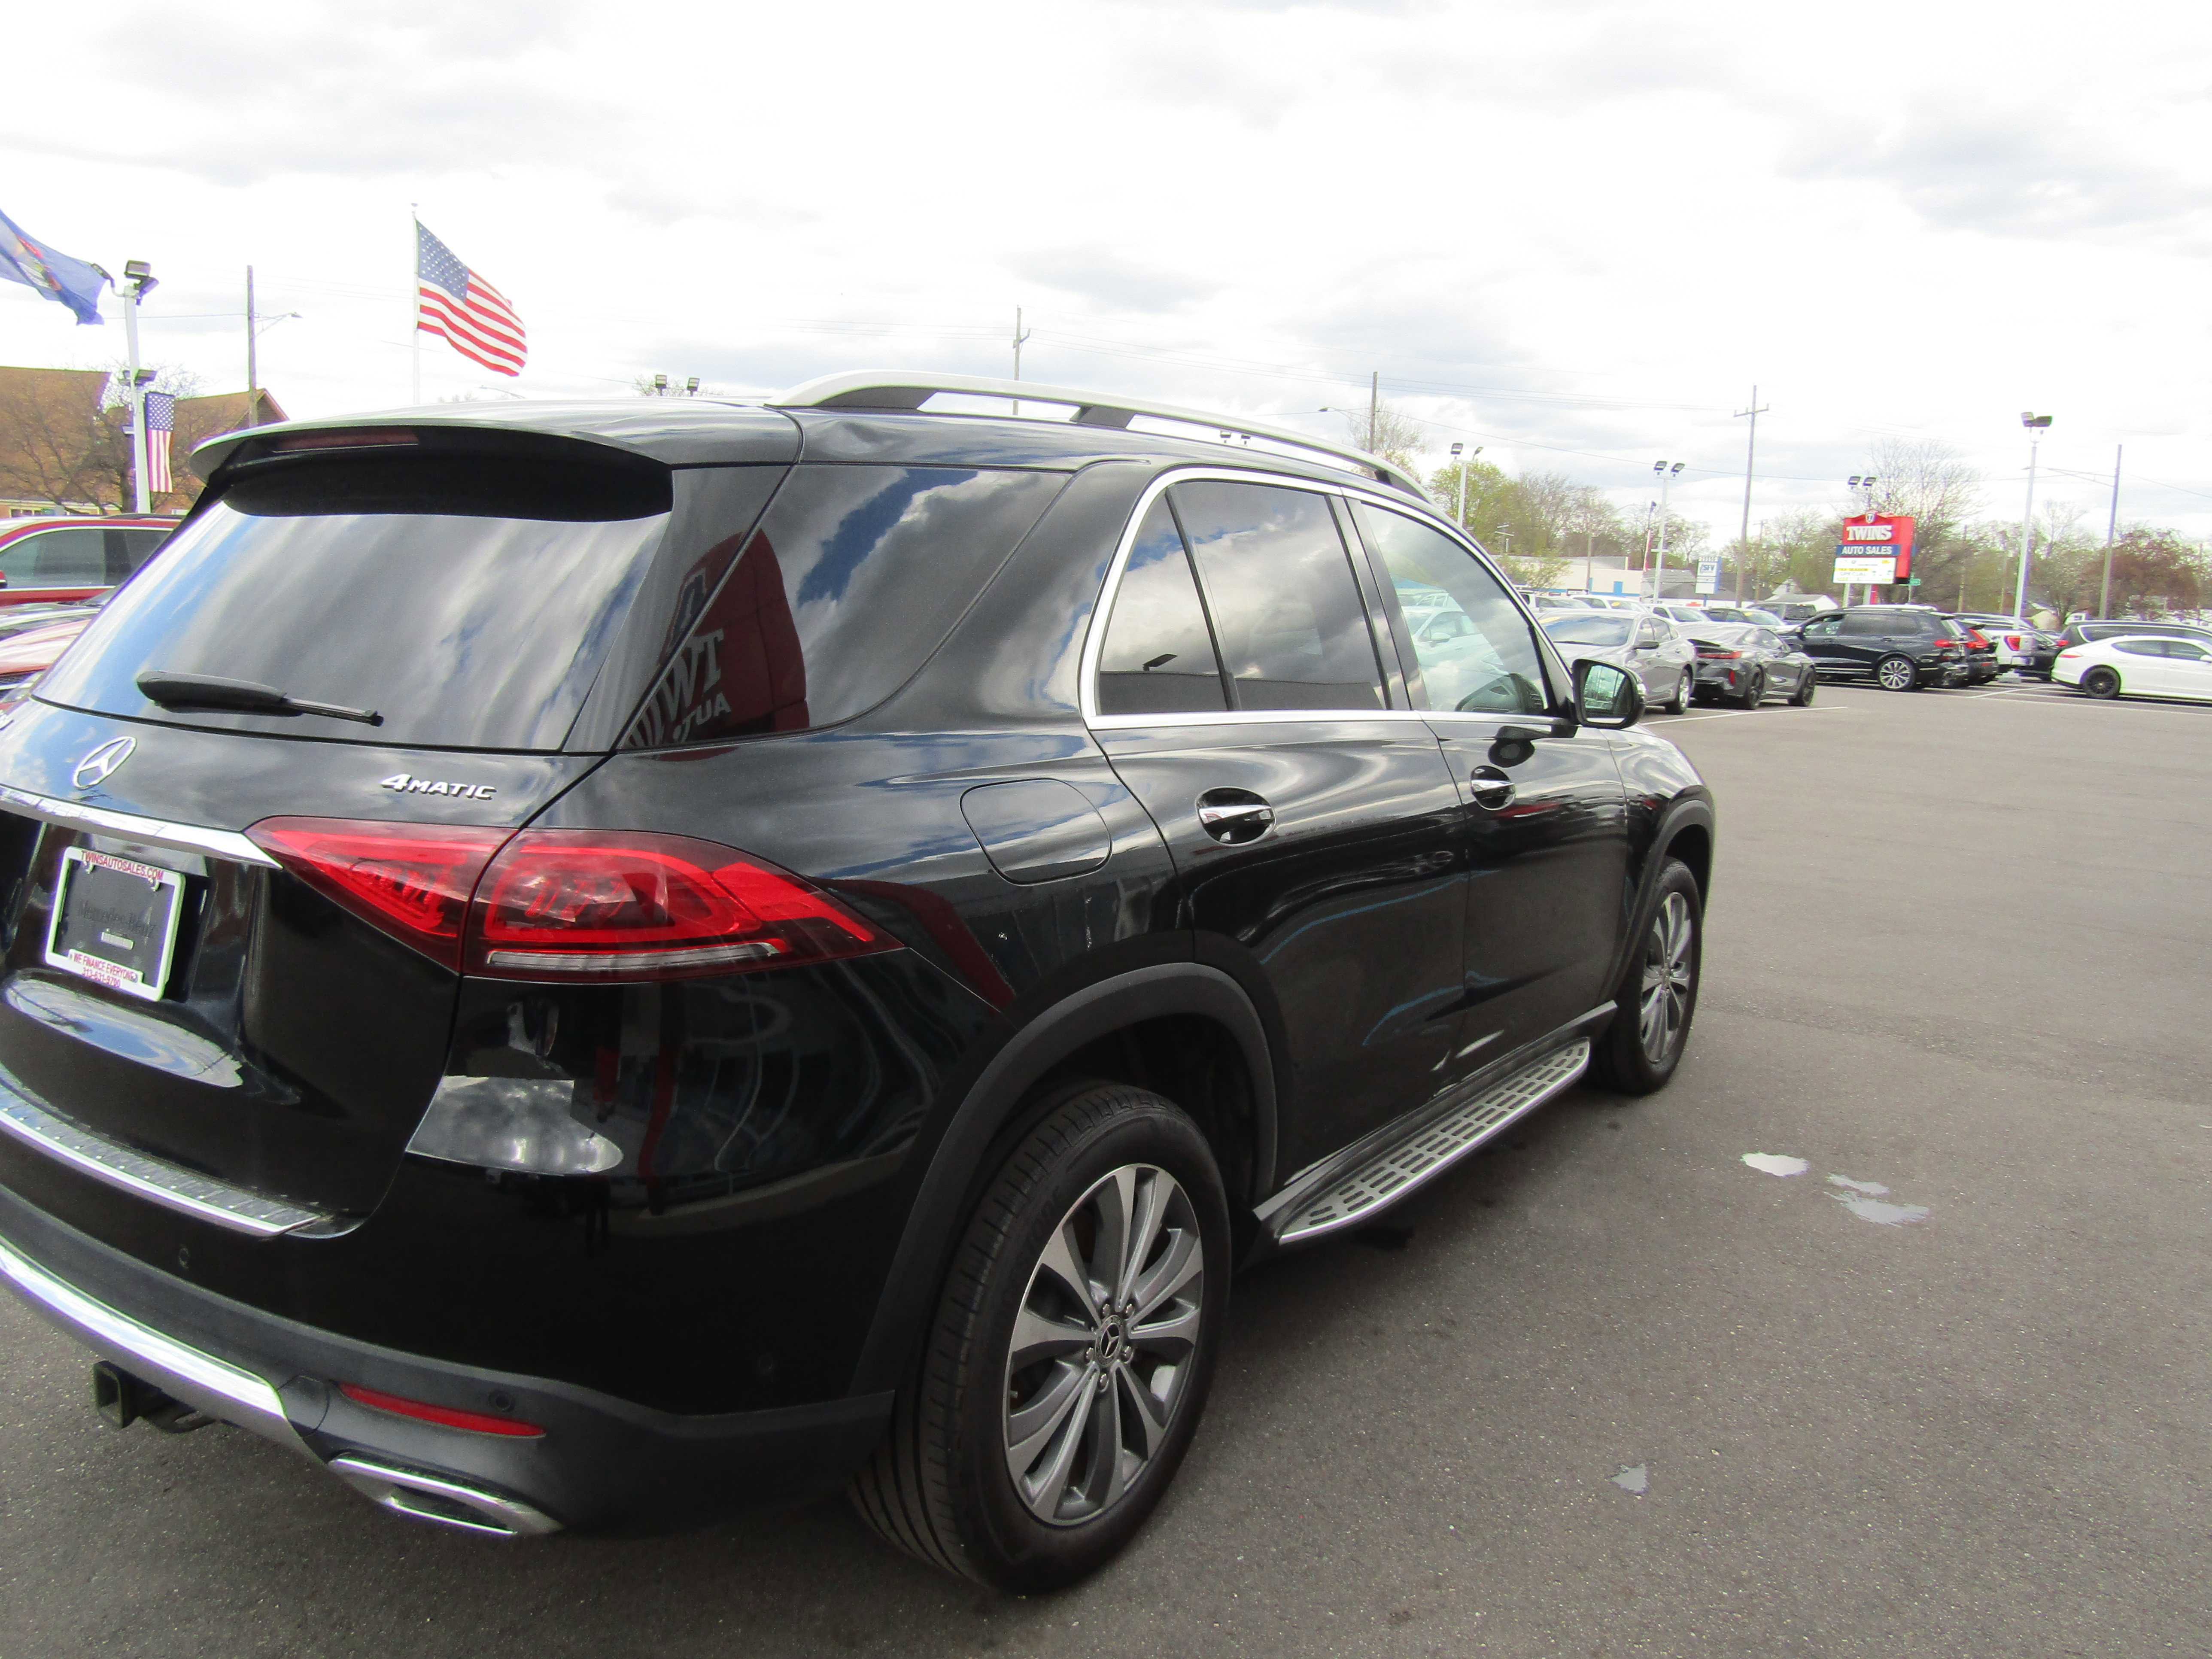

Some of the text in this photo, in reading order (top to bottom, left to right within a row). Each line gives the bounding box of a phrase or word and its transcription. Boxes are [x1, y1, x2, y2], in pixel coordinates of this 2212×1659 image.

[1846, 525, 1893, 541] TWINS
[1841, 546, 1893, 554] AUTO SALES
[380, 773, 497, 800] 4MATIC
[81, 850, 164, 880] TWINSAUTOSALES.COM
[74, 953, 82, 963] WE
[82, 955, 106, 971] FINANCE
